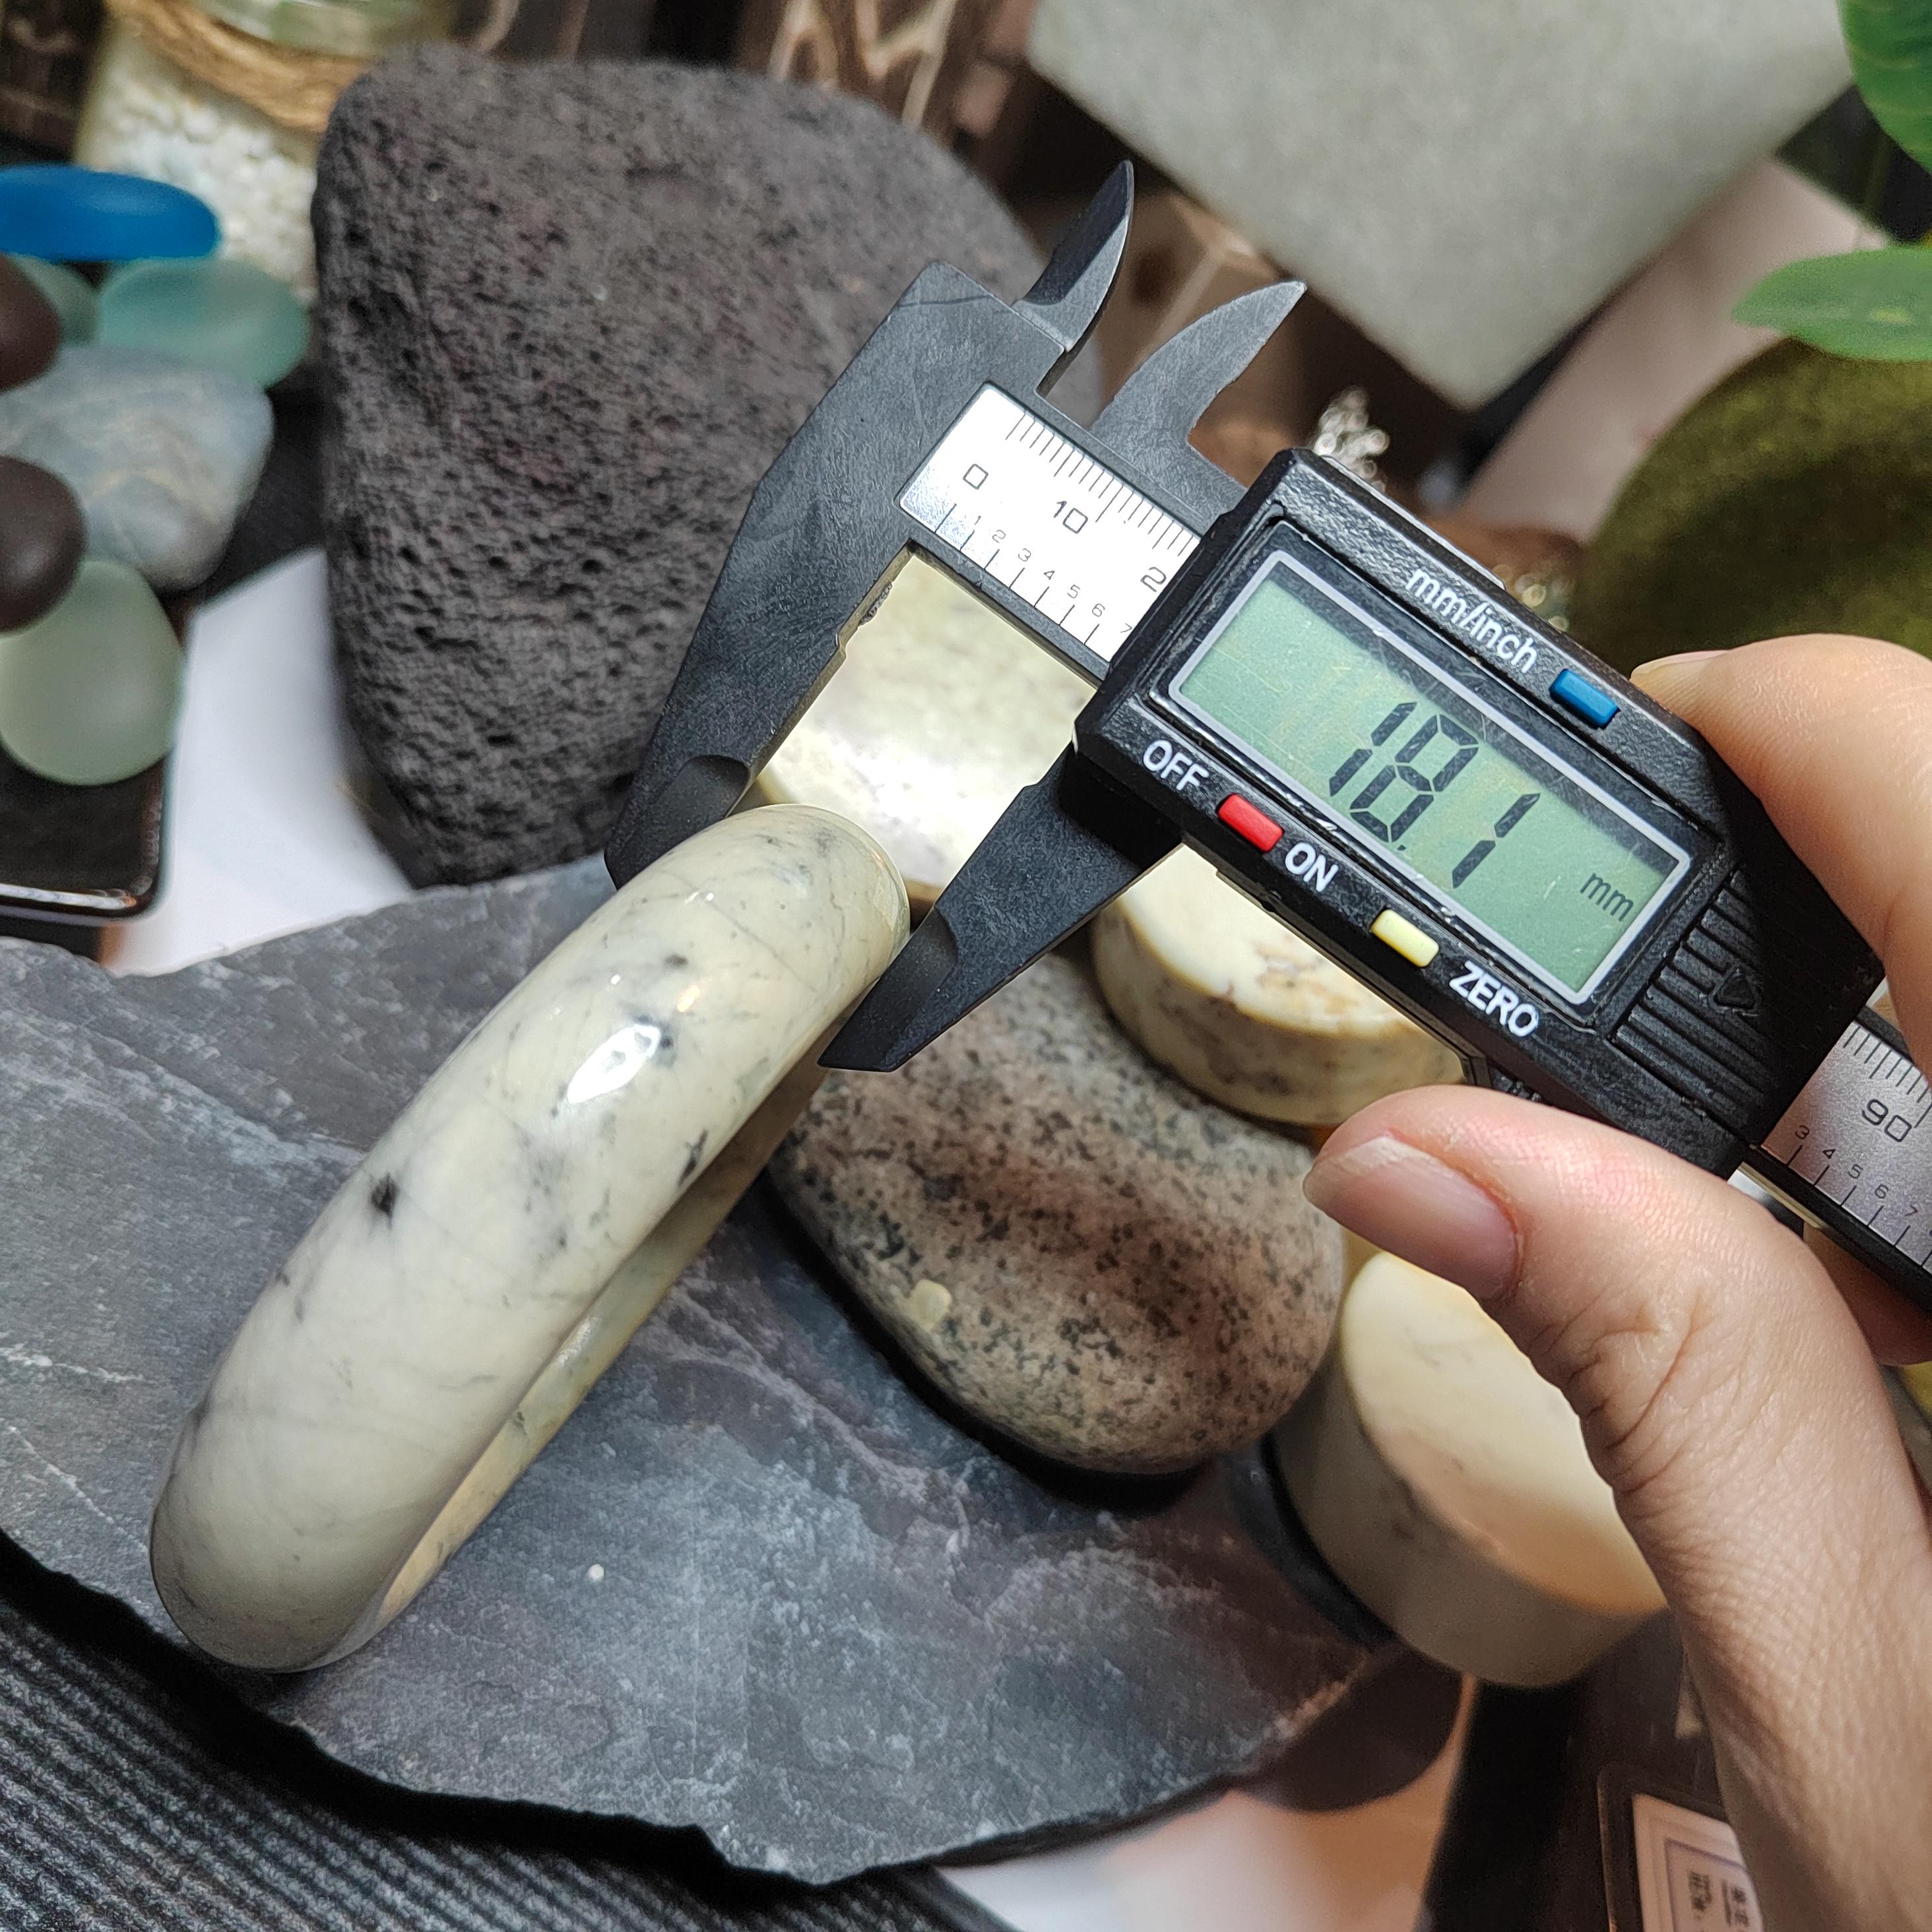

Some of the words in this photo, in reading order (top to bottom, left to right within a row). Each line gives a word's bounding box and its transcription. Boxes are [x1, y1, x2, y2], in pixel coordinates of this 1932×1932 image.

[962, 463, 989, 490] 0
[1053, 500, 1089, 534] 10
[1140, 566, 1167, 593] 2
[992, 529, 1007, 544] 2
[1017, 548, 1032, 562] 3
[1043, 569, 1056, 581] 4
[1067, 584, 1081, 600] 5
[1091, 603, 1106, 618] 6
[1119, 622, 1134, 635] 7
[1404, 565, 1539, 674] mm/inch
[1142, 739, 1209, 793] OFF
[1328, 701, 1541, 889] 18.1
[1580, 870, 1636, 923] mm
[1284, 842, 1339, 893] ON
[1449, 960, 1539, 1038] ZERO
[1861, 1097, 1913, 1143] 90
[1793, 1124, 1811, 1141] 3
[1821, 1147, 1836, 1160] 4
[1847, 1163, 1864, 1180] 5
[1873, 1183, 1889, 1200] 6
[1904, 1204, 1919, 1218] 7
